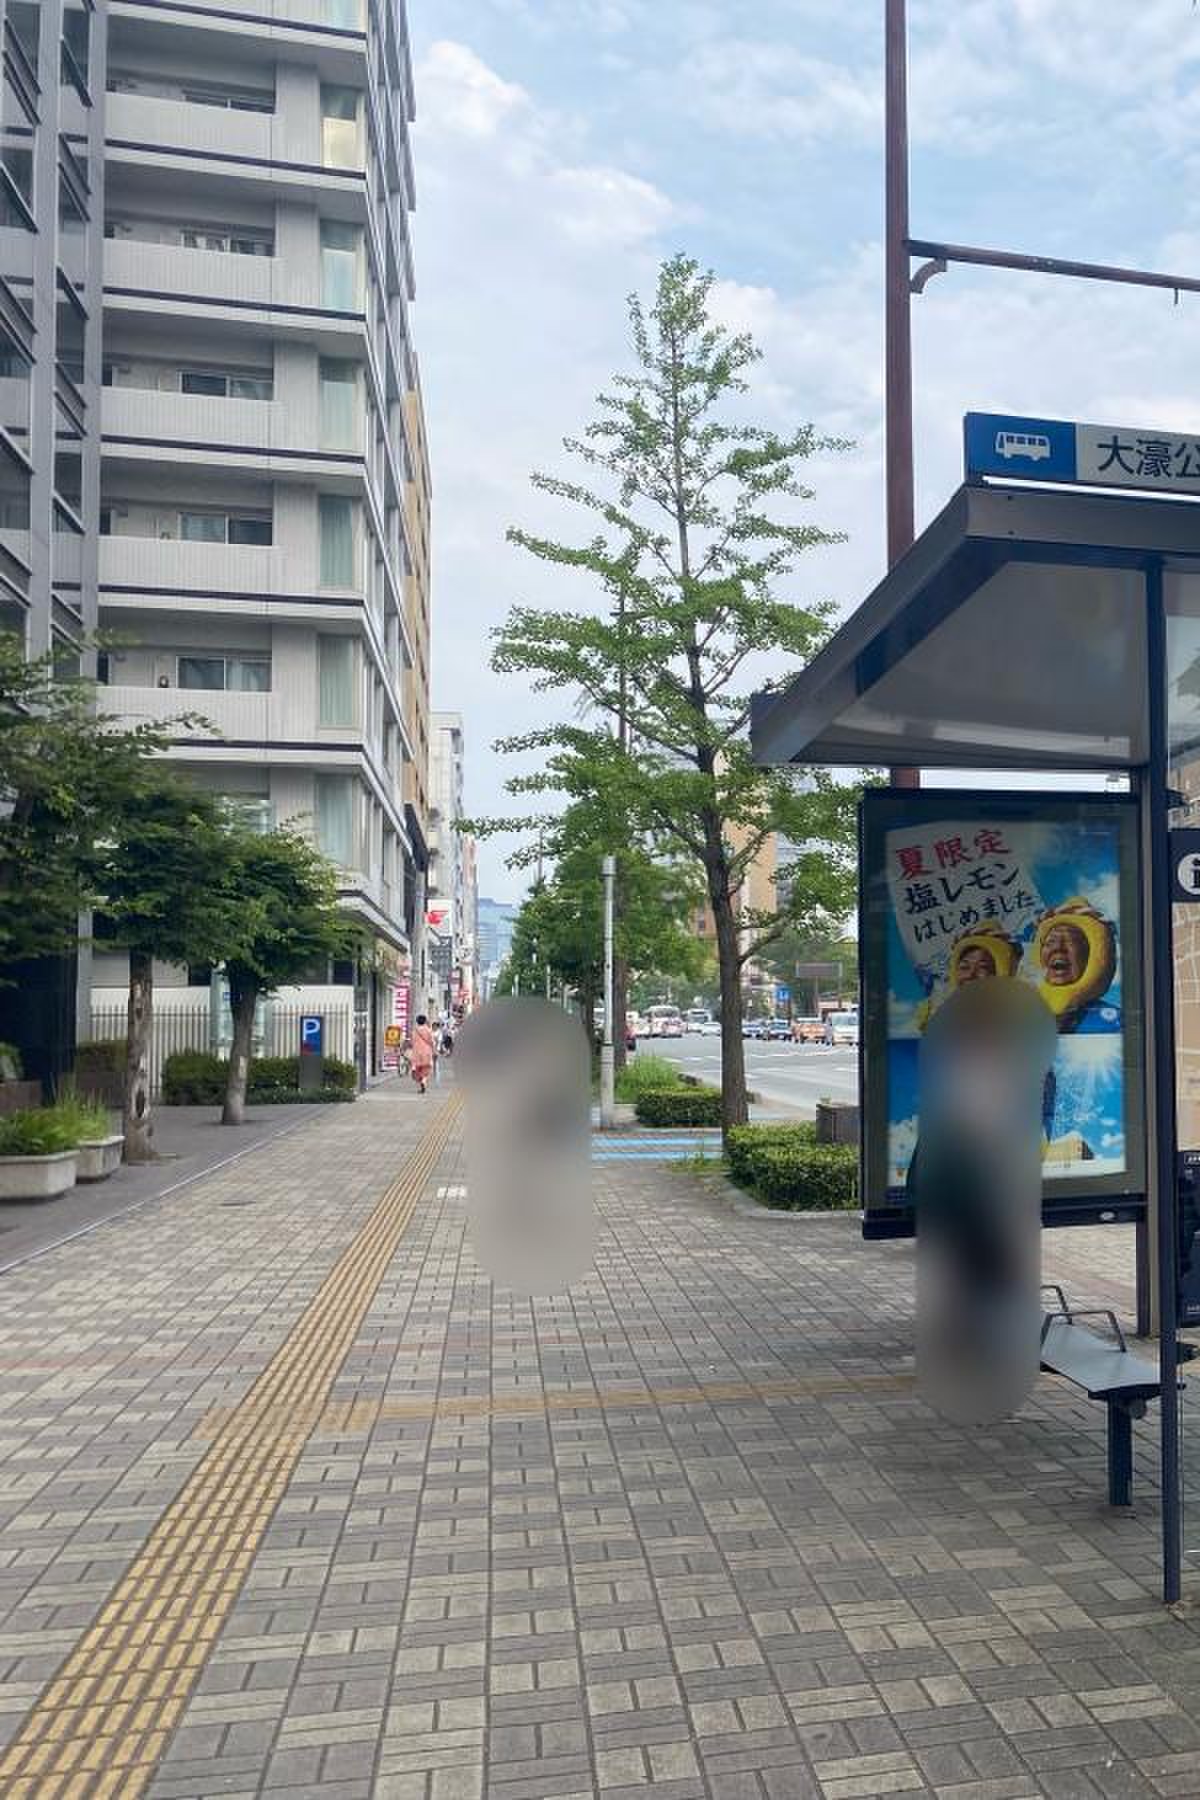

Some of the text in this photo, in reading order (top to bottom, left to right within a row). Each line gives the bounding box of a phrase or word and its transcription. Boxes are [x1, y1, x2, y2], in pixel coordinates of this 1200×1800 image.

[896, 828, 1013, 882] 夏限定
[904, 862, 1020, 916] 塩レモン
[913, 889, 1036, 944] はじめました
[303, 1018, 321, 1041] P
